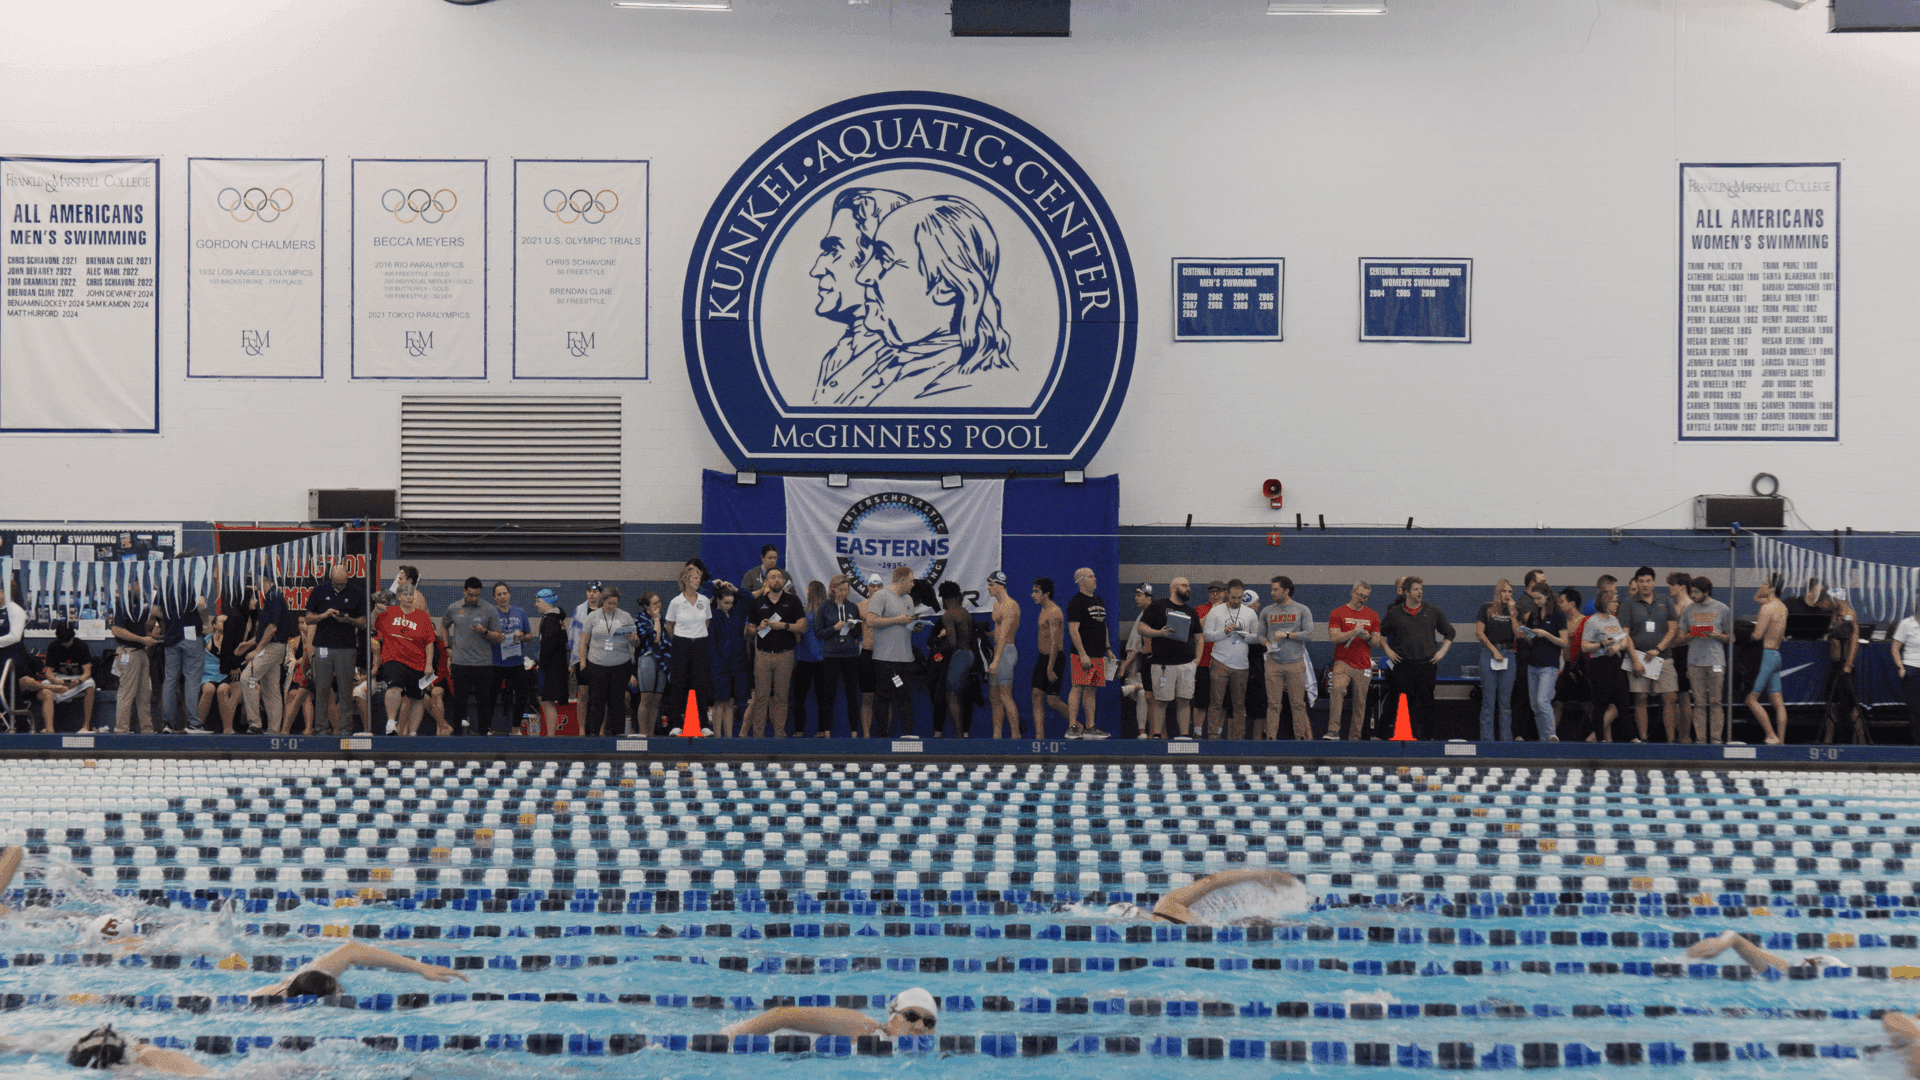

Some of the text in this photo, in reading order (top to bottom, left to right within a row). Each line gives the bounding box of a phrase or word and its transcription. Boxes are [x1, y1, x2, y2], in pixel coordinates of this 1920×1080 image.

[815, 118, 1007, 173] AQUATIC
[104, 175, 151, 188] COLLEGE
[1786, 180, 1832, 192] COLLEGE
[14, 204, 143, 223] ALL AMERICANS
[1696, 209, 1824, 228] ALL AMERICANS
[10, 230, 147, 245] MEN'S SWIMMING
[374, 237, 465, 246] BECCA MEYERS
[522, 237, 641, 245] 2021 U.S. OLYMPIC TRIALS
[709, 162, 808, 320] KUNKEL
[1014, 161, 1111, 320] CENTER
[1692, 235, 1829, 249] WOMEN'S SWIMMING
[196, 239, 316, 249] GORDON CHALMERS
[8, 256, 77, 265] CHRIS SCHIAVONE 2021
[86, 257, 152, 265] BRENDAN CLINE 2021
[86, 268, 138, 276] ALEC WAHL 2022
[8, 278, 21, 286] TOM
[60, 278, 76, 286] 2022
[86, 278, 153, 287] CHRIS SCHIAVONE 2022
[1200, 279, 1257, 287] MEN'S SWIMMING
[1382, 279, 1449, 287] WOMEN'S SWIMMING
[8, 289, 74, 297] BRENDAN CLINE 2022
[86, 290, 153, 298] JOHN DEVANEY 2024
[133, 300, 148, 308] 2024
[62, 310, 78, 318] 2024
[965, 426, 1048, 449] POOL
[842, 495, 944, 529] INTERSCHOLASTIC
[17, 535, 117, 544] DIPLOMAT SWIMMING
[836, 536, 950, 557] EASTERNS
[392, 617, 418, 630] HUN
